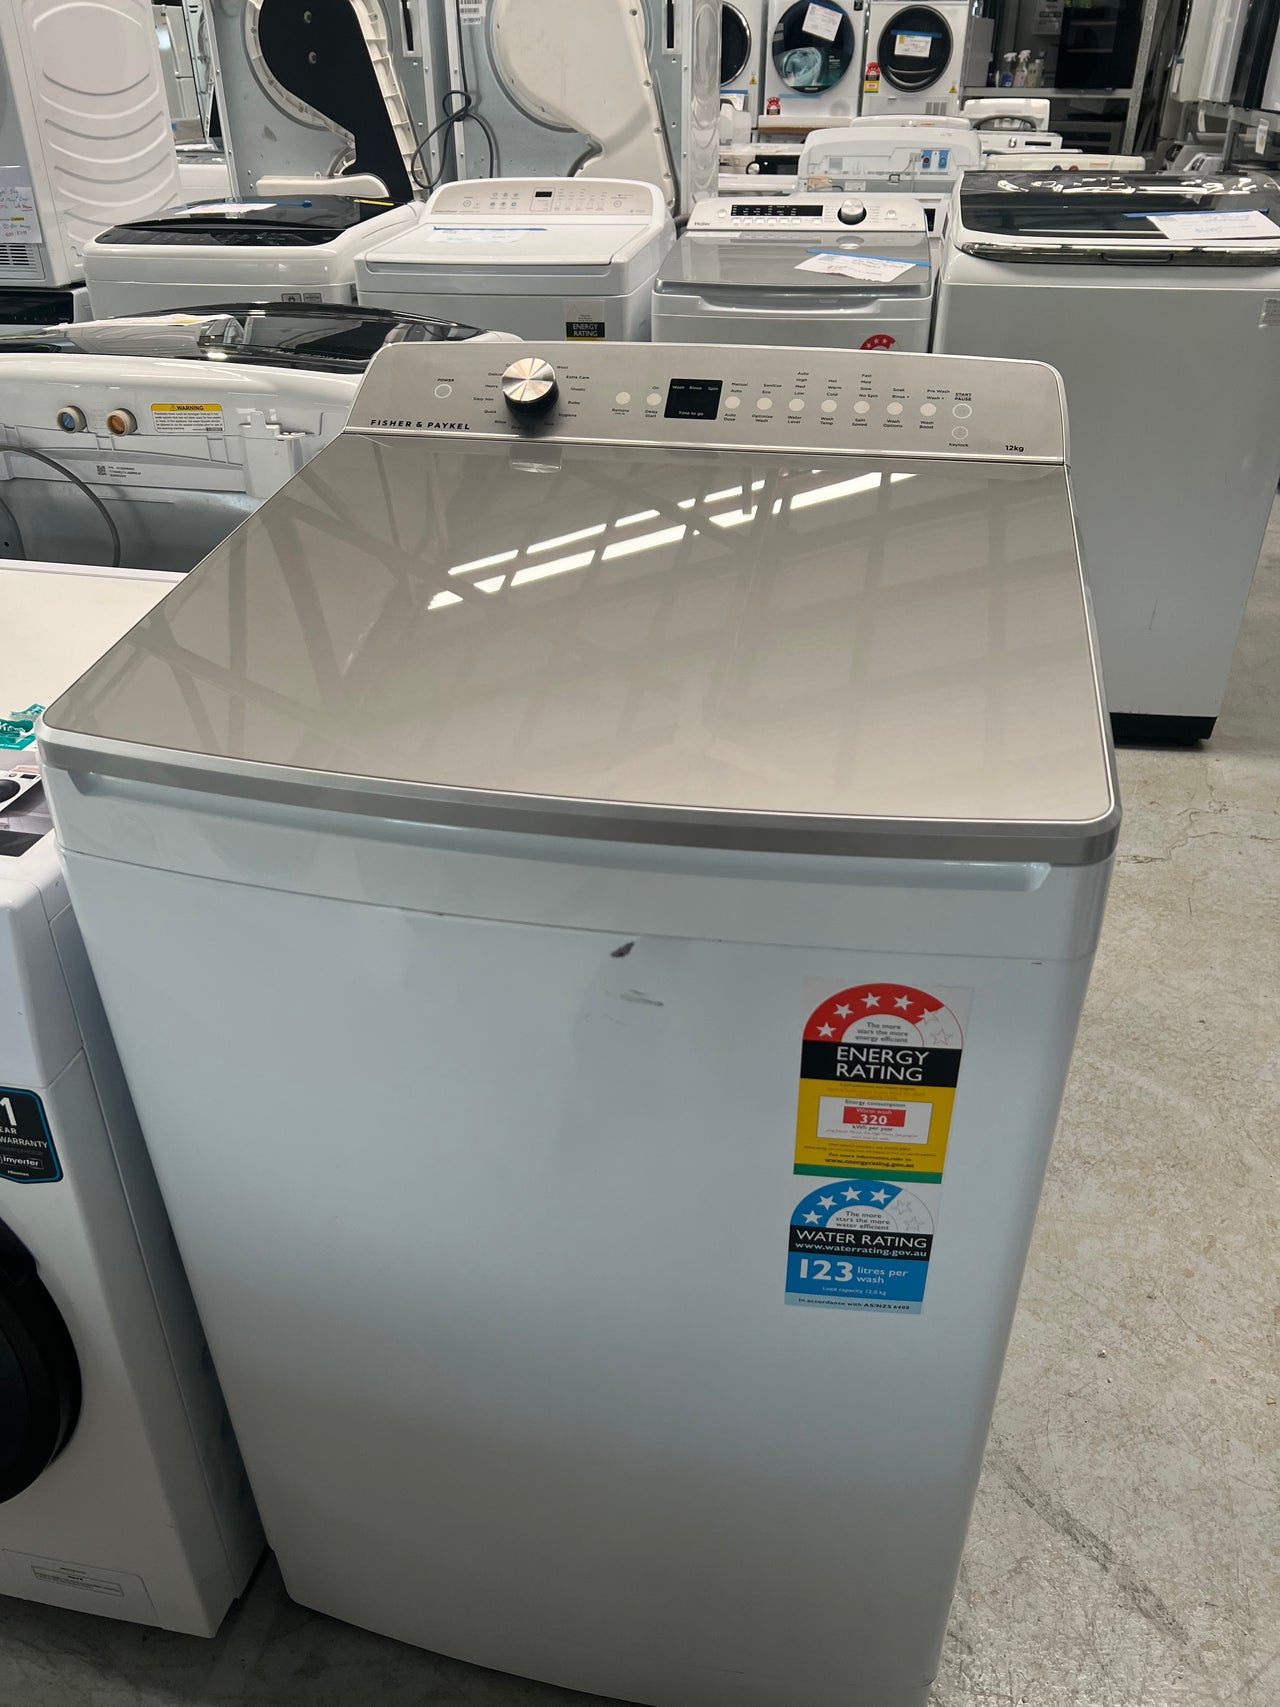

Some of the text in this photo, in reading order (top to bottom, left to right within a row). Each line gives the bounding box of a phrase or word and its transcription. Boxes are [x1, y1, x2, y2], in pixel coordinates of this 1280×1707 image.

[370, 419, 412, 428] FISHER
[427, 422, 470, 430] PAYKEL
[1005, 444, 1024, 453] 12kg
[855, 1035, 908, 1043] energy efficient
[836, 1046, 930, 1066] ENERGY
[836, 1063, 923, 1082] RATING
[859, 1114, 888, 1125] 320
[825, 1158, 915, 1168] www.energyrating.gov.au
[796, 1230, 928, 1248] WATER RATING
[795, 1242, 927, 1257] www.waterrating.gov.au
[800, 1258, 908, 1282] 123 litres per
[856, 1276, 885, 1284] wash
